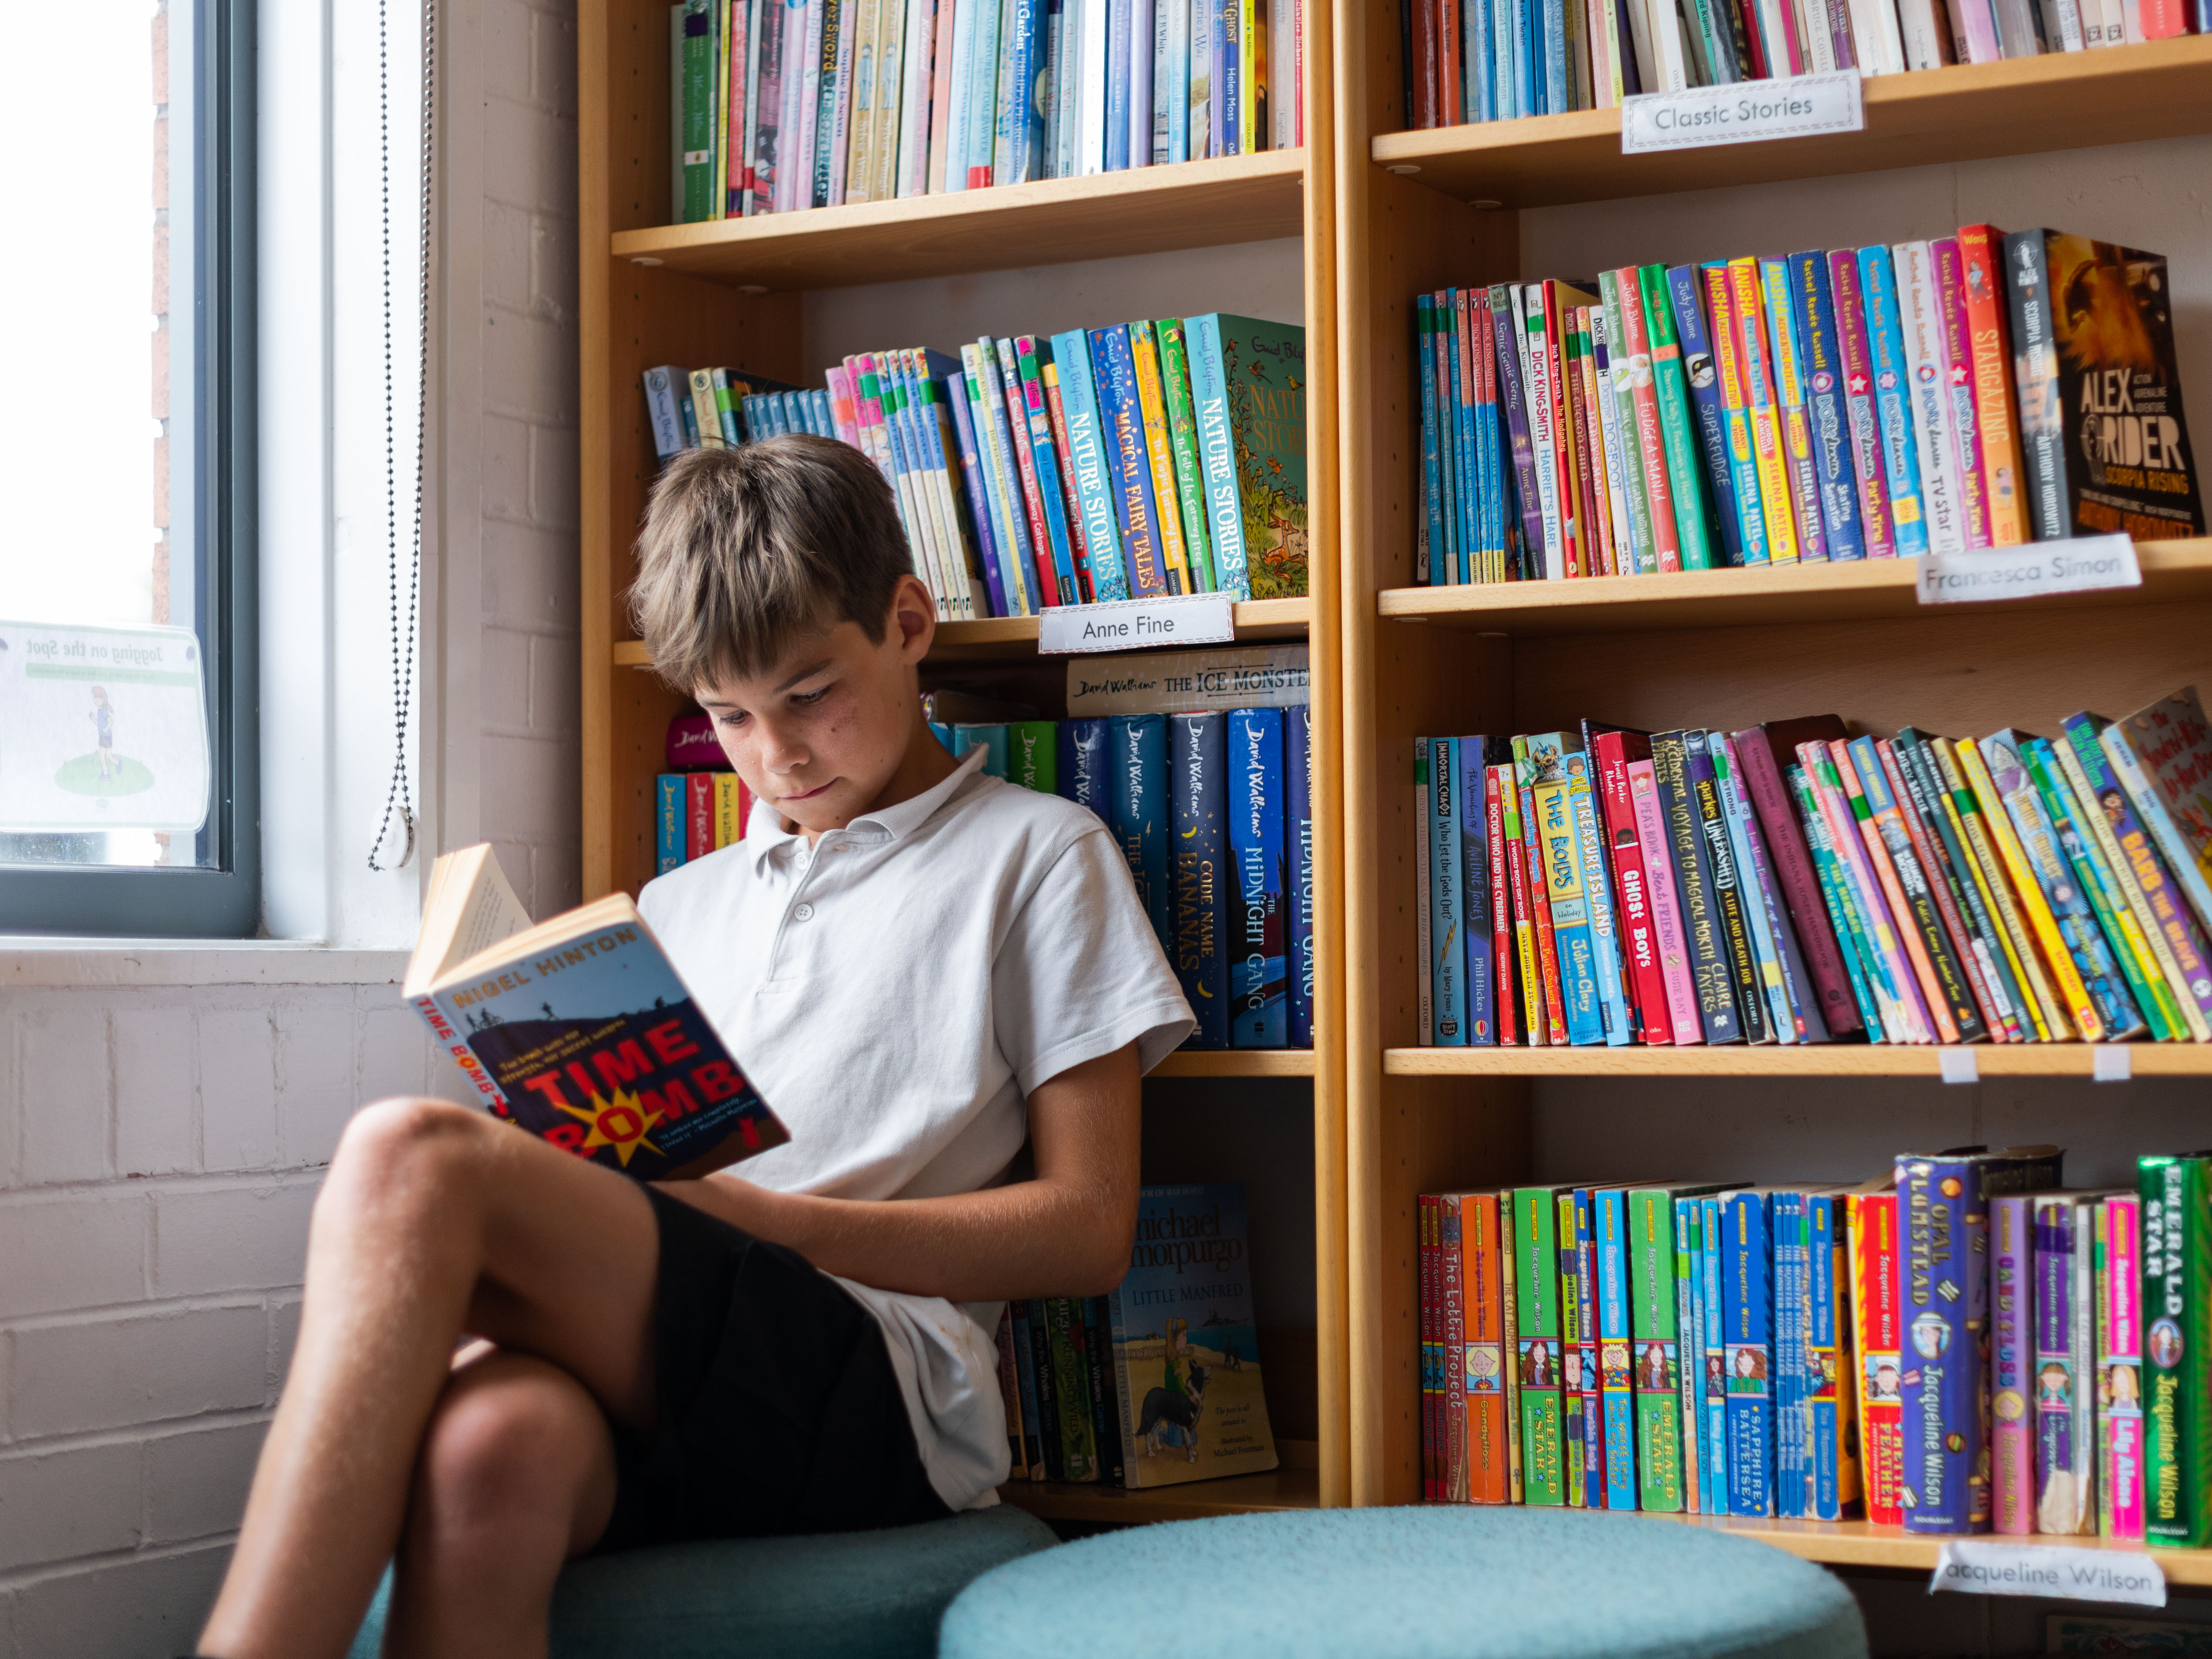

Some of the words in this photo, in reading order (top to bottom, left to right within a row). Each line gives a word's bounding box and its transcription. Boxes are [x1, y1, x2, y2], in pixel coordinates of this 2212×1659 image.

[824, 24, 838, 70] Sword
[1016, 8, 1031, 50] Garden
[1195, 35, 1207, 59] War
[1224, 8, 1238, 43] GHOST
[823, 85, 834, 107] Ian
[1227, 68, 1236, 94] Helen
[1499, 55, 1508, 100] Stevenson
[1656, 104, 1729, 130] Classic
[1738, 97, 1813, 122] Stories
[817, 113, 833, 198] Serraillier
[1499, 322, 1508, 350] Genie
[1501, 351, 1513, 379] Genie
[1532, 351, 1544, 377] DICK
[1975, 329, 2009, 443] STARGAZING
[1012, 396, 1023, 424] Enid
[1534, 378, 1549, 442] KING-SMITH
[2081, 368, 2134, 413] ALEX
[1014, 423, 1029, 458] Blyton
[1115, 411, 1139, 483] MAGICAL
[1177, 437, 1185, 451] The
[1179, 450, 1191, 473] Folk
[1202, 396, 1231, 483] NATURE
[1603, 423, 1621, 491] DOGFOOT
[1639, 402, 1666, 502] FUDGE-A-MANIA
[1701, 404, 1731, 487] SUPERFUDGE
[2036, 436, 2054, 481] ANTHONY
[2103, 416, 2186, 470] RIDER
[1023, 462, 1031, 480] The
[1180, 474, 1189, 483] of
[1182, 484, 1194, 497] the
[1521, 467, 1529, 490] Anne
[1525, 491, 1533, 511] Fine
[1541, 449, 1554, 511] HARRIET'S
[1023, 482, 1038, 521] Fly-Away
[1070, 411, 1102, 495] NATURE
[1086, 497, 1118, 580] STORIES
[1125, 484, 1148, 533] FAIRY
[2042, 484, 2061, 537] HOROWITZ
[1032, 522, 1045, 556] Cottage
[1185, 497, 1200, 540] Faraway
[1214, 486, 1243, 570] STORIES
[1545, 515, 1556, 548] HARE
[1133, 535, 1156, 589] TALES
[1191, 537, 1203, 563] Tree
[1925, 564, 2042, 590] Francesca
[2050, 556, 2123, 579] Simon
[1082, 621, 1130, 639] Anne
[1137, 616, 1175, 635] Fine
[1074, 680, 1109, 698] David
[1111, 680, 1157, 695] Walliams
[1165, 678, 1193, 693] THE
[1196, 672, 1228, 693] ICE
[1233, 668, 1310, 691] MONSTE
[1128, 722, 1143, 765] David
[1187, 718, 1204, 764] David
[1245, 719, 1265, 770] David
[1437, 742, 1449, 787] IMMORTAL
[1605, 771, 1614, 794] Rhodes
[1613, 759, 1624, 781] Jewell
[1129, 763, 1145, 820] Walliams
[1189, 762, 1204, 817] Walliams
[1246, 769, 1265, 839] Walliams
[1437, 787, 1451, 816] CHAOS
[1545, 789, 1562, 831] THE
[1569, 785, 1589, 794] CLASSICS
[1617, 782, 1627, 804] Parker
[1438, 821, 1451, 842] Who
[1489, 803, 1498, 835] DOCTOR
[1438, 843, 1451, 858] Let
[1440, 860, 1451, 873] the
[1468, 846, 1485, 886] AVELINE
[1551, 836, 1574, 890] BOLDS
[1571, 795, 1601, 872] TREASURE
[1587, 875, 1611, 938] ISLAND
[1704, 818, 1735, 890] UNLEASHED
[1200, 860, 1213, 903] CODE
[1244, 846, 1267, 945] MIDNIGHT
[1439, 874, 1452, 898] Gods
[1492, 873, 1503, 890] THE
[1178, 851, 1200, 971] BANANAS
[1267, 898, 1276, 915] THE
[1440, 899, 1452, 920] Out?
[1469, 888, 1485, 921] JONES
[1495, 890, 1505, 932] CYBERMEN
[1557, 908, 1581, 918] Holiday
[1200, 911, 1214, 957] NAME
[1916, 900, 1930, 925] Public
[1926, 926, 1941, 953] Enemy
[1938, 955, 1953, 984] Number
[1948, 983, 1960, 1001] Two
[452, 968, 532, 1009] NIGEL
[535, 926, 639, 978] HINTON
[1475, 957, 1484, 977] Phil
[1571, 939, 1589, 977] Julian
[1245, 952, 1266, 1011] GANG
[1443, 976, 1452, 993] Mary
[1443, 994, 1452, 1012] Evans
[1578, 979, 1594, 1012] Clary
[1697, 966, 1716, 1013] FAYERS
[1712, 963, 1732, 1010] CLAIRE
[416, 996, 457, 1041] TIME
[451, 1042, 496, 1096] BOMB
[524, 1017, 701, 1111] TIME
[543, 1060, 747, 1160] BOMB
[1130, 1238, 1243, 1274] morpurgo
[1907, 1163, 1931, 1306] PLUMSTEAD
[1930, 1203, 1950, 1265] OPAL
[2146, 1199, 2163, 1276] STAR
[2165, 1164, 2183, 1315] EMERALD
[1445, 1254, 1458, 1283] The
[1531, 1246, 1540, 1298] Jacqueline
[1133, 1288, 1175, 1305] LITTLE
[1180, 1282, 1244, 1301] MANFRED
[1446, 1290, 1461, 1340] Lottie
[1533, 1301, 1542, 1332] Wilson
[1448, 1345, 1462, 1408] Project
[1917, 1363, 1945, 1451] Jacqueline
[2152, 1373, 2179, 1462] Jacqueline
[1480, 1400, 1490, 1470] Candyfloss
[1534, 1420, 1545, 1471] STAR
[1545, 1396, 1558, 1495] EMERALD
[2113, 1419, 2134, 1453] Lily
[1739, 1409, 1752, 1508] BATTERSEA
[1750, 1415, 1762, 1501] SAPPHIRE
[1924, 1453, 1945, 1506] Wilson
[2118, 1455, 2135, 1507] Alone
[2159, 1464, 2179, 1519] Wilson
[1946, 1561, 2059, 1586] acqueline
[2070, 1566, 2152, 1591] Wilson
